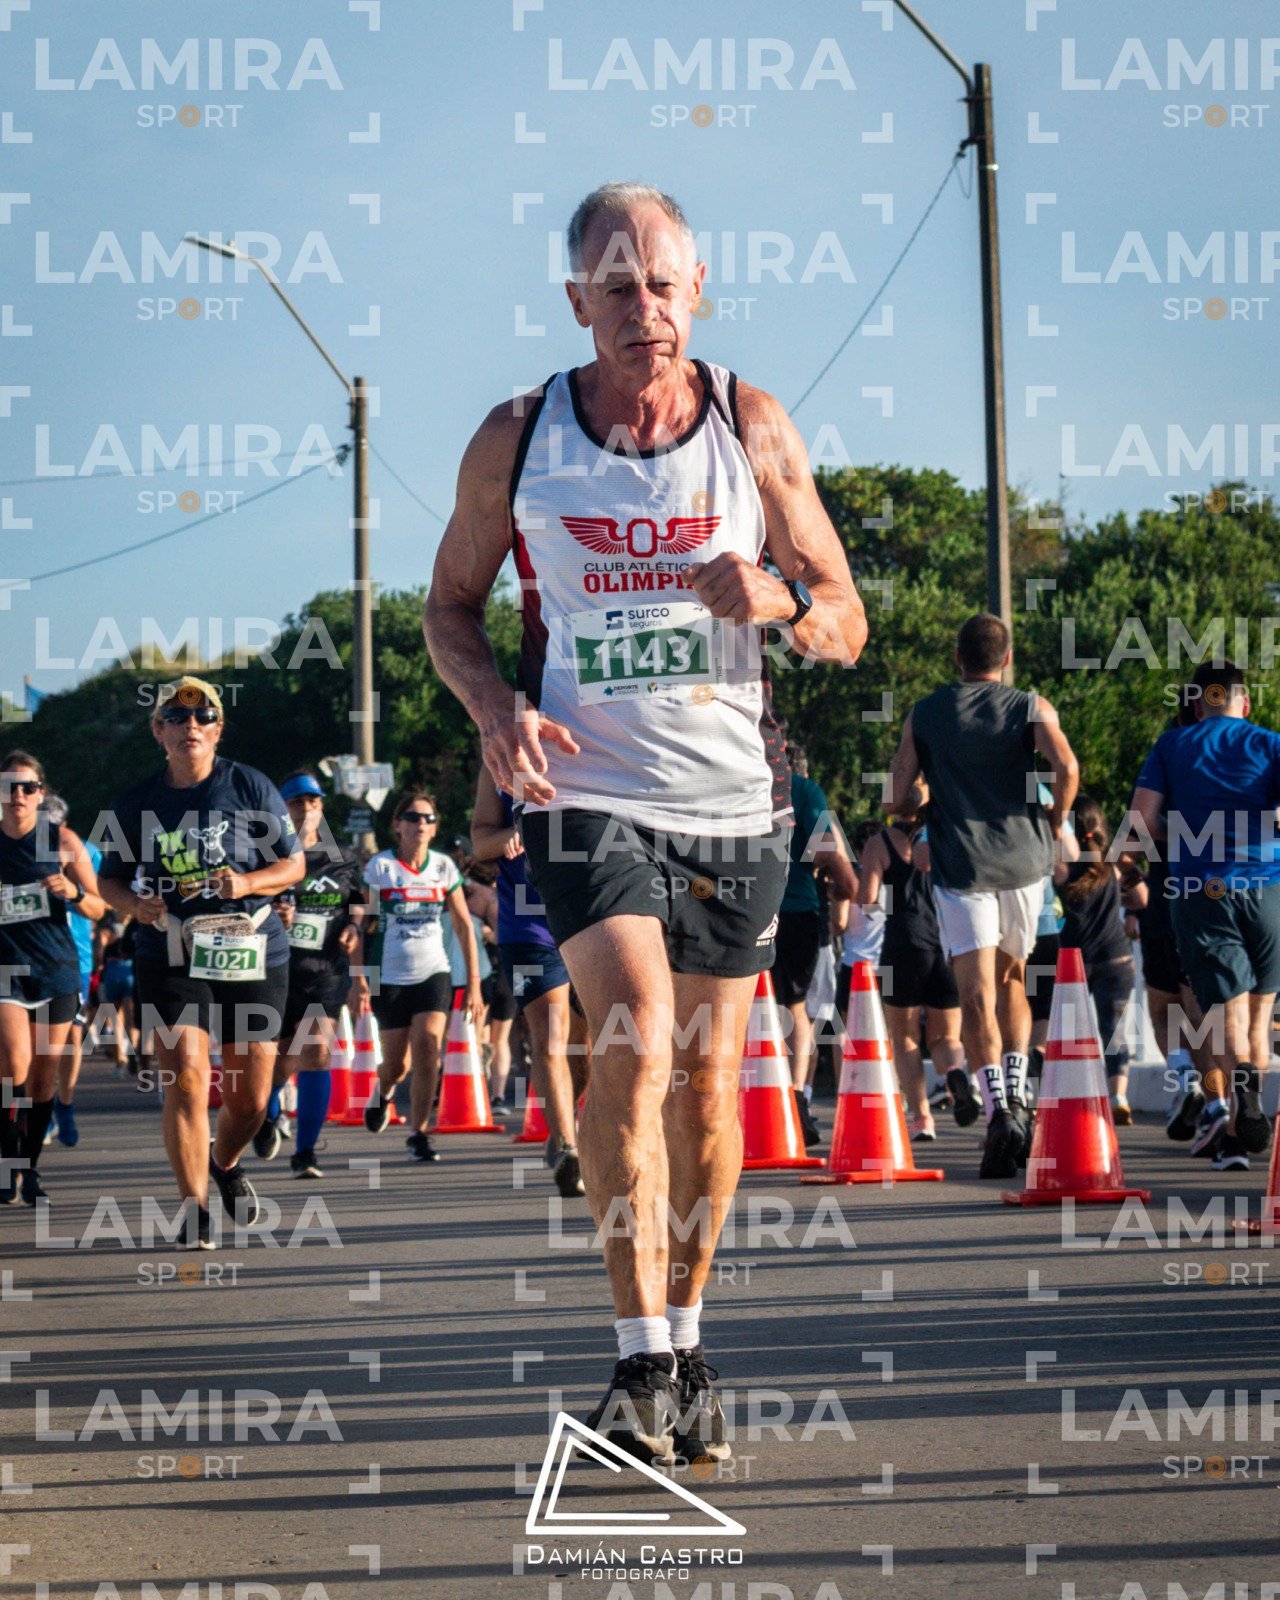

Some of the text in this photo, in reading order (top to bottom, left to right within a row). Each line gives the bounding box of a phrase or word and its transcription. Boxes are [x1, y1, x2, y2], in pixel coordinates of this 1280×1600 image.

[584, 561, 690, 573] CLUB ATLÉTIC
[583, 572, 695, 594] OLIMPI
[628, 607, 670, 620] surco
[594, 635, 691, 679] 1143
[204, 949, 251, 970] 1021
